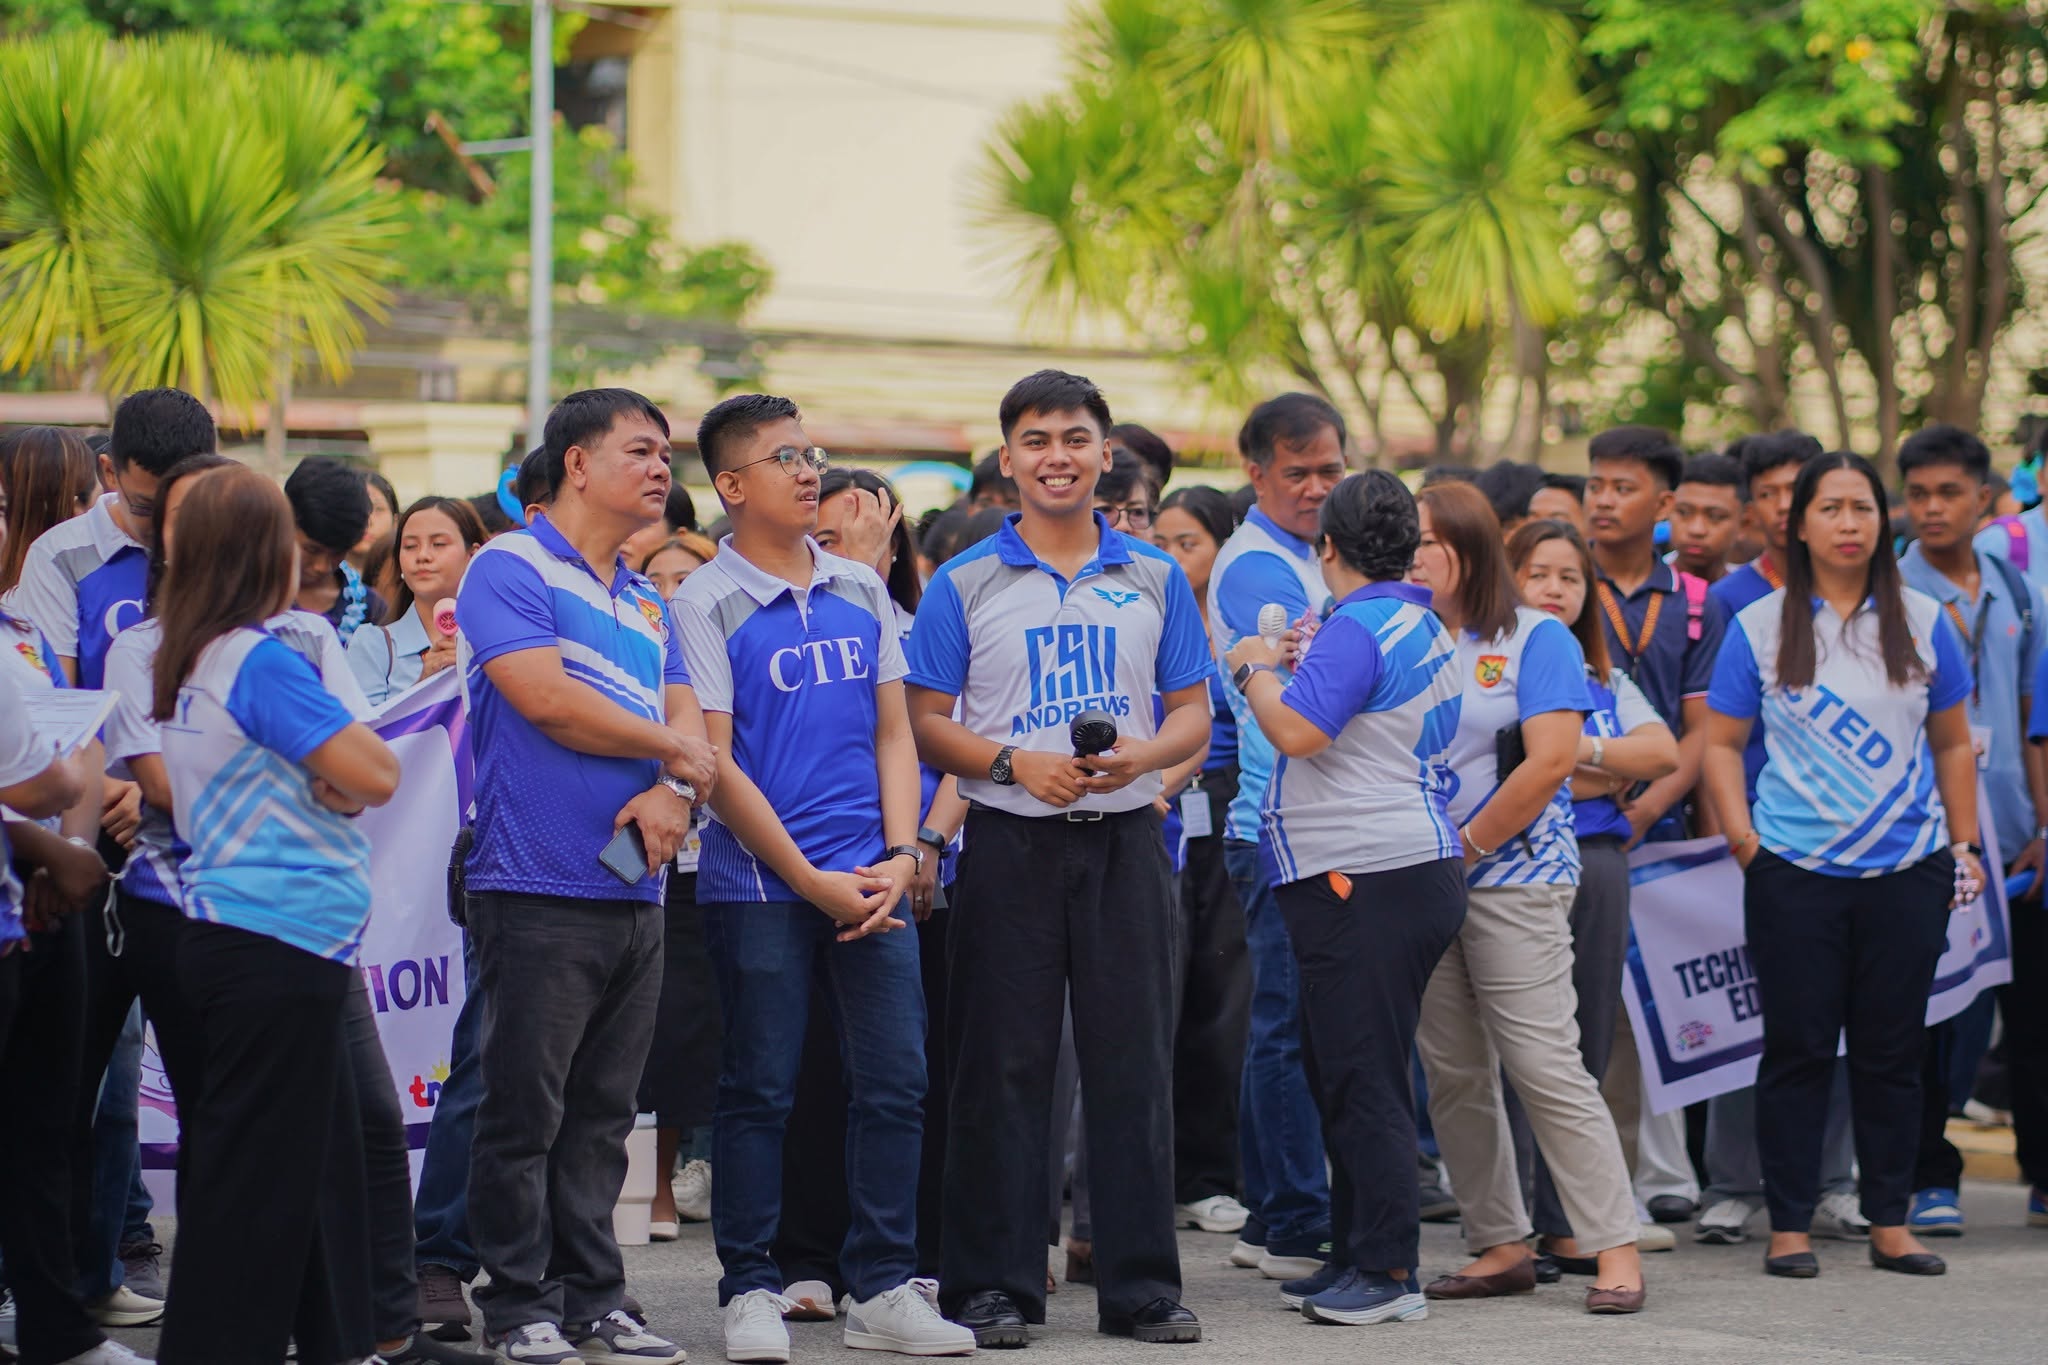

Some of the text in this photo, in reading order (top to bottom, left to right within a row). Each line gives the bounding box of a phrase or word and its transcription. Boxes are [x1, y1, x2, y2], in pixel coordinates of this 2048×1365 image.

[769, 637, 869, 692] CTE
[1025, 624, 1115, 710] CSU
[363, 956, 449, 1013] ION
